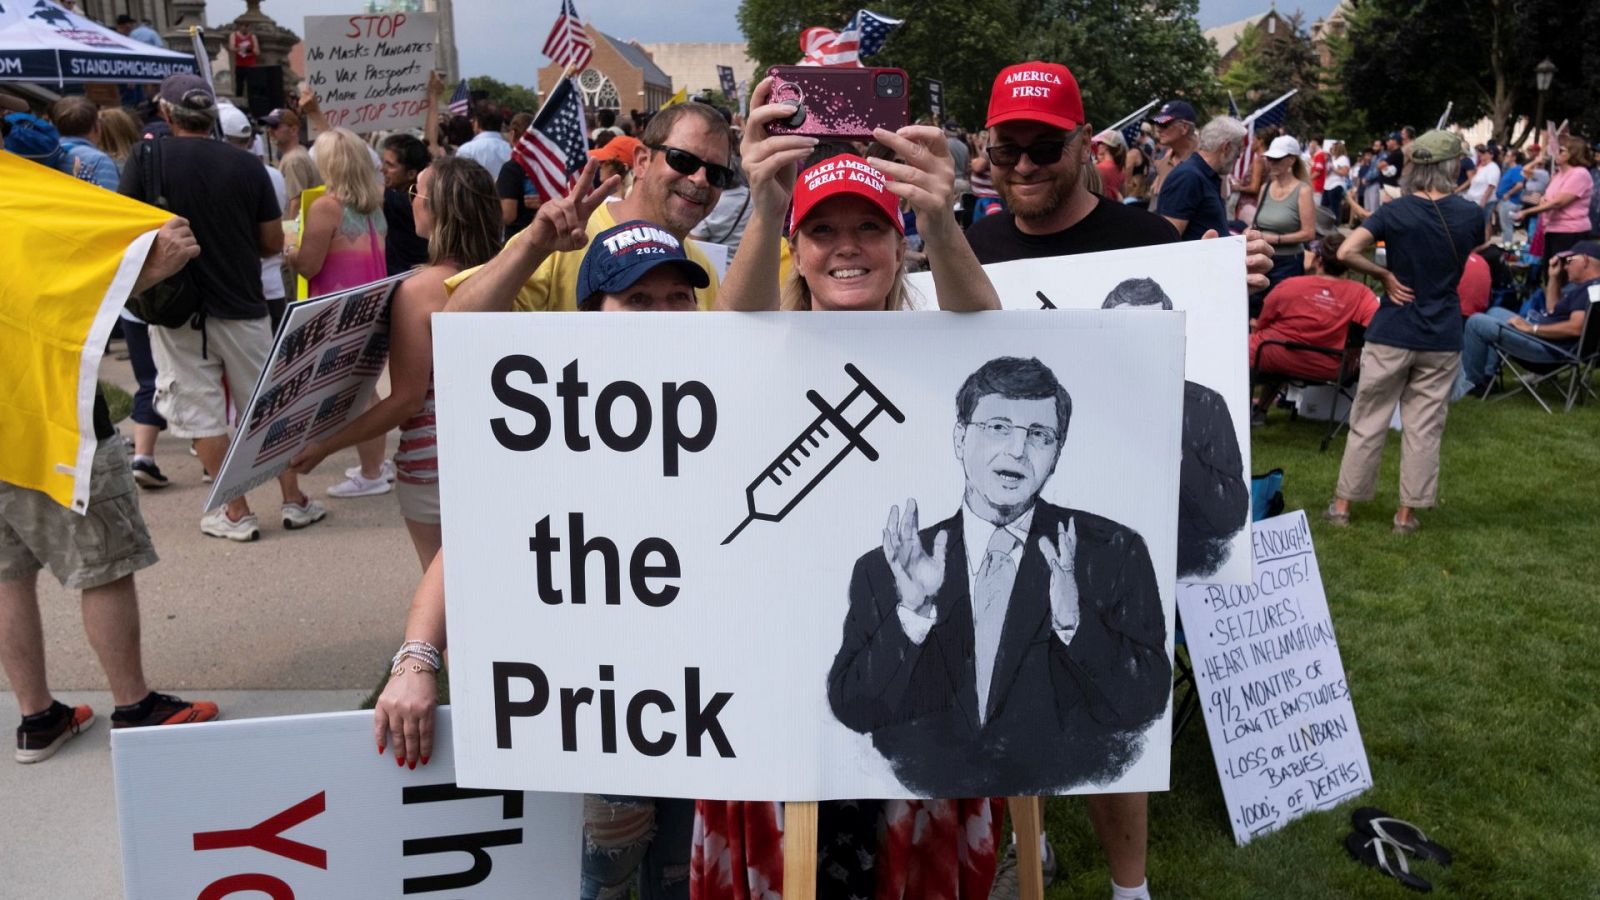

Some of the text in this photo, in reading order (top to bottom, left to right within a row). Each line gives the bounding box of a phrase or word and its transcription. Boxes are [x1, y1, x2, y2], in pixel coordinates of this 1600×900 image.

[345, 13, 406, 38] STOP
[1004, 70, 1061, 85] AMERICA
[1012, 86, 1050, 98] FIRST
[323, 99, 430, 127] TOP STOP STOP
[804, 159, 887, 184] MAKE AMERICA
[808, 170, 884, 193] GREAT AGAIN
[602, 226, 680, 255] TRUMP
[635, 246, 666, 255] 2024
[490, 354, 718, 477] Stop
[1252, 514, 1310, 559] ENOUGH!
[529, 512, 682, 608] the
[1260, 556, 1309, 595] CLOTS!
[1215, 598, 1305, 646] SEIZURES!
[1205, 646, 1248, 684] HEART
[1241, 667, 1302, 712] MONTHS
[1306, 660, 1323, 680] OF
[492, 661, 737, 758] Prick
[1222, 717, 1263, 744] LONG
[1228, 746, 1268, 779] LOSS
[1288, 714, 1348, 755] UNBORN
[1287, 789, 1304, 809] OF
